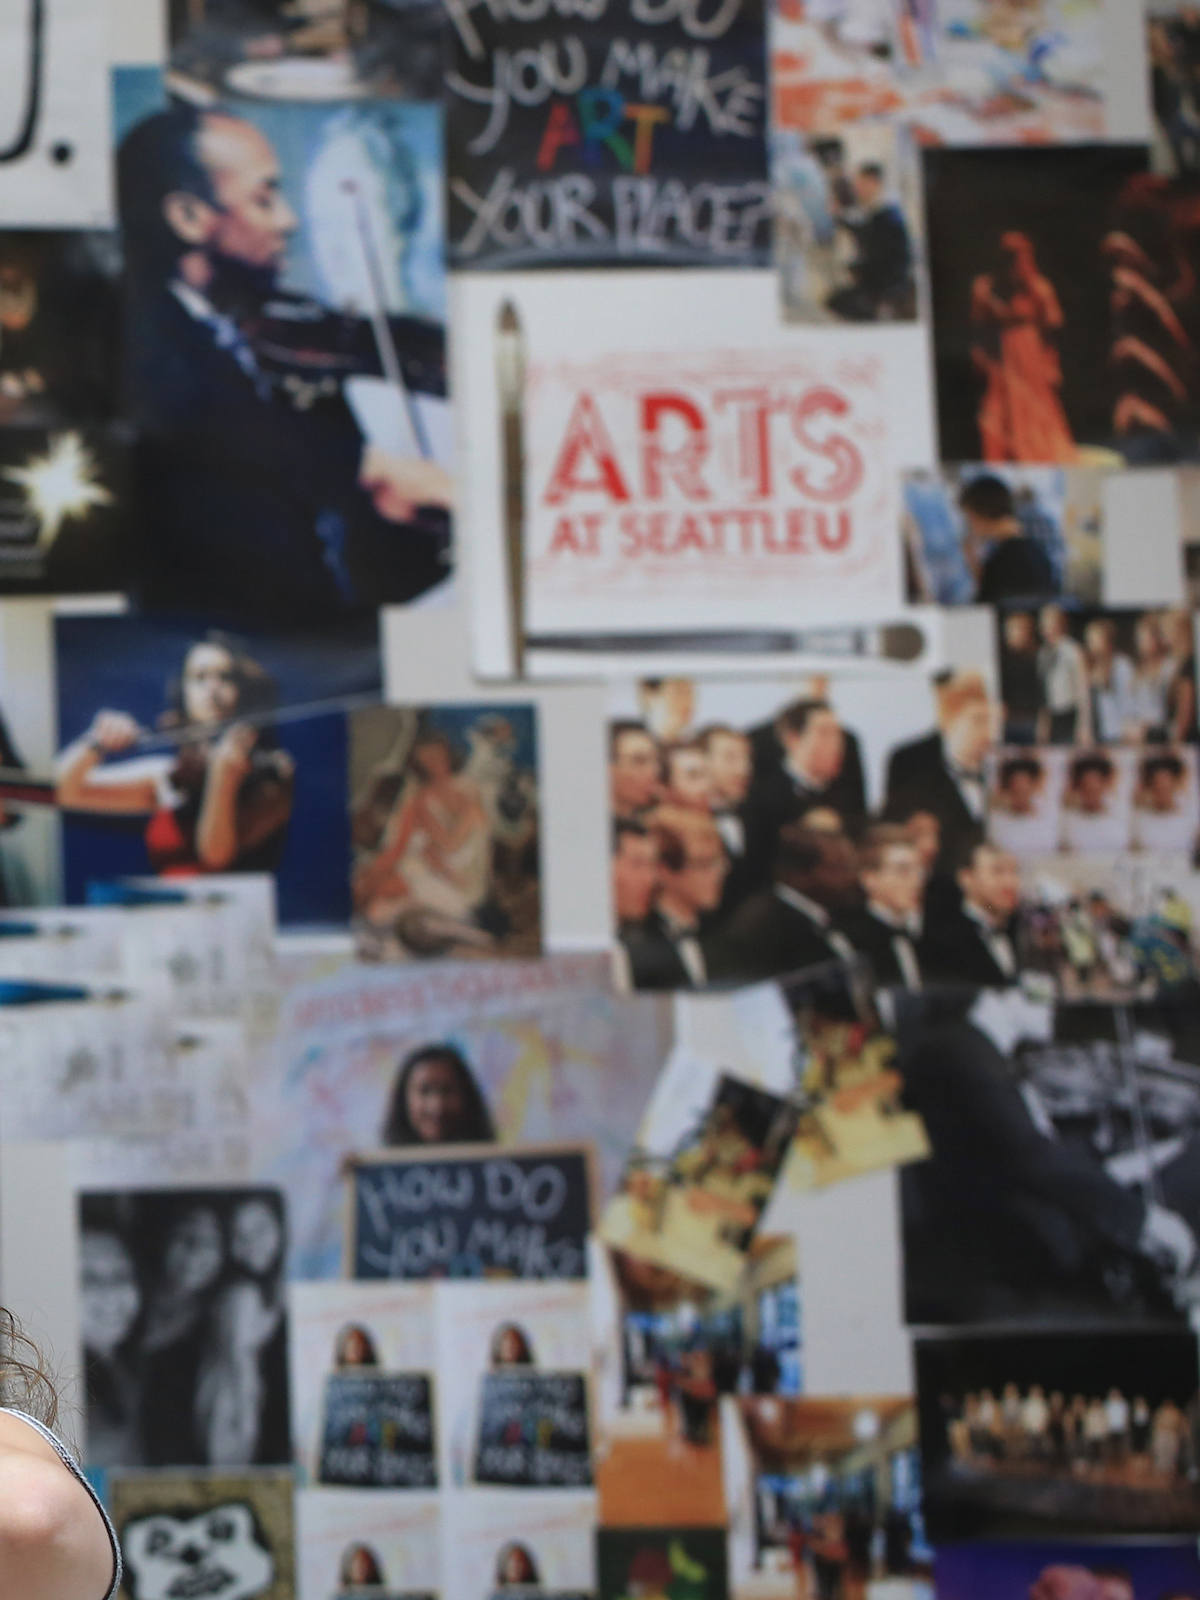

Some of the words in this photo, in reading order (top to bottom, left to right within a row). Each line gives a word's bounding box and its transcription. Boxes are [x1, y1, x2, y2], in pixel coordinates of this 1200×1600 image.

[535, 86, 671, 174] ART
[544, 385, 866, 504] ARTS
[550, 511, 602, 557] AT
[617, 509, 853, 557] SEATTLEU
[484, 1157, 568, 1222] DO
